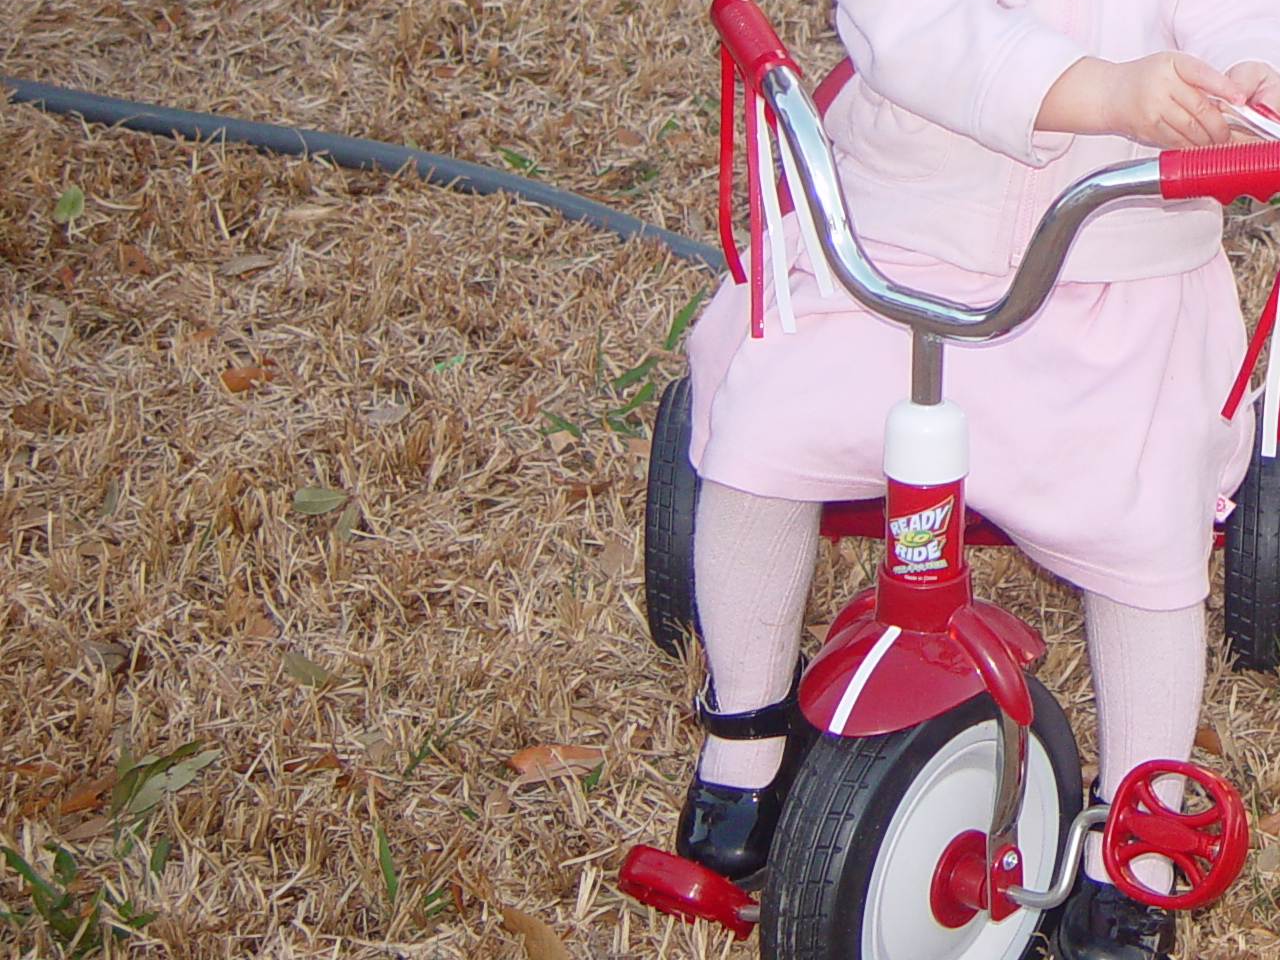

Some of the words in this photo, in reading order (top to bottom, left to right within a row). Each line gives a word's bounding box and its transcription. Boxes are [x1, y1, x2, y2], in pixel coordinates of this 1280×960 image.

[889, 505, 951, 537] READY
[905, 533, 930, 543] to
[895, 540, 941, 562] RIDE
